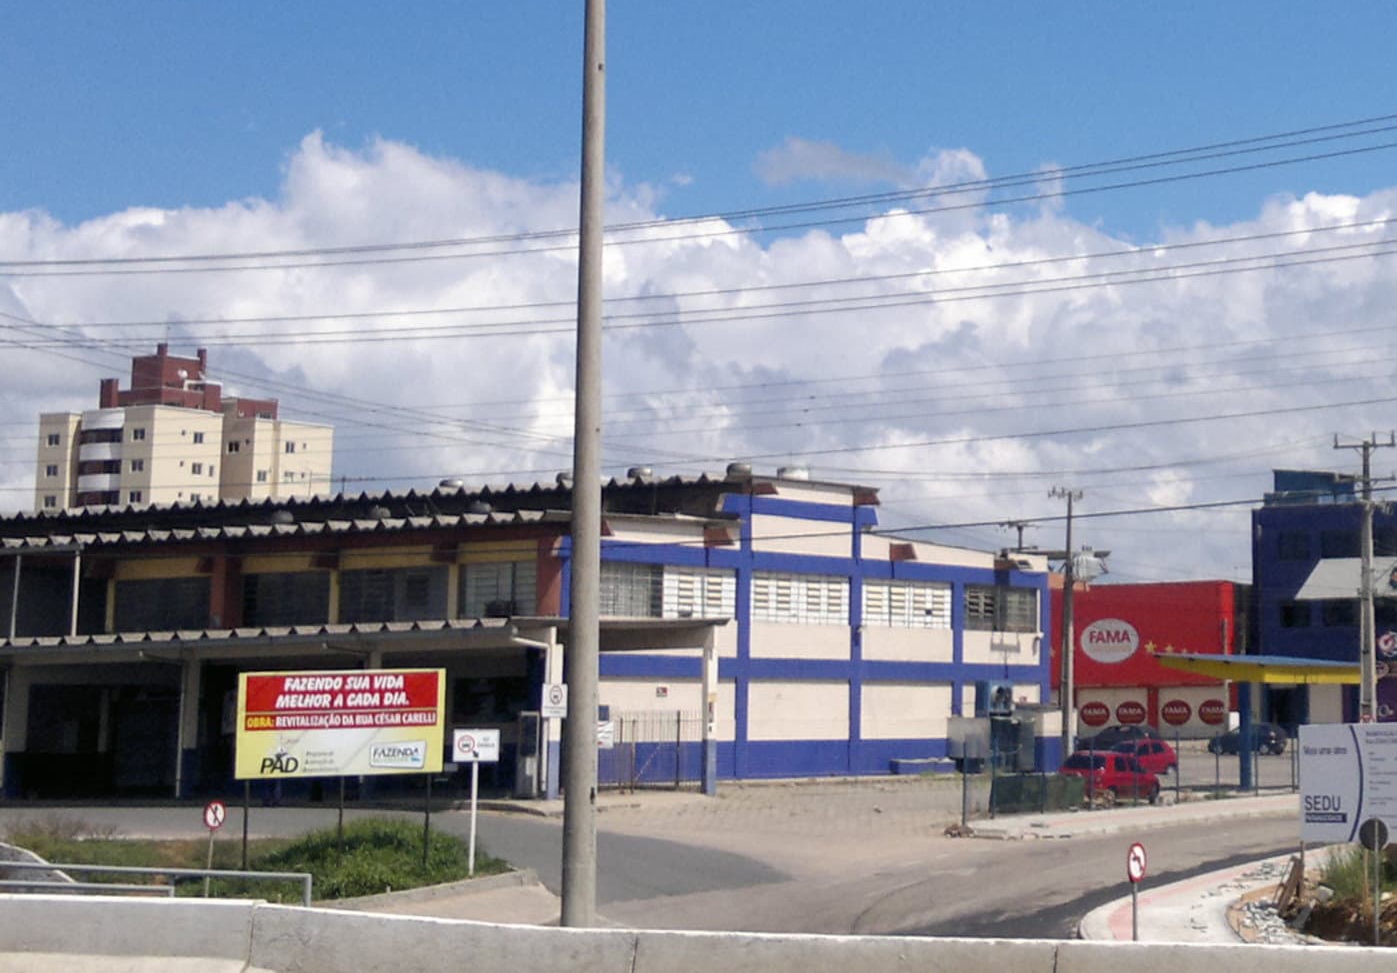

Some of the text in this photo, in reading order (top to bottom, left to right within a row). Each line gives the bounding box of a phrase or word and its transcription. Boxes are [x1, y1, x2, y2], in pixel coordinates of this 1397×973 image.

[1089, 630, 1131, 644] FAMA
[284, 674, 404, 692] FAZENDO SUA VIDA
[275, 691, 410, 708] MELHOR A CADA DIA.
[247, 711, 436, 729] OBRA: REVITALIZAÇÃO DA RUA CÉSAR CARELLI
[373, 746, 419, 757] FAZENDA
[260, 757, 298, 774] PAD
[1305, 795, 1341, 811] SEDU
